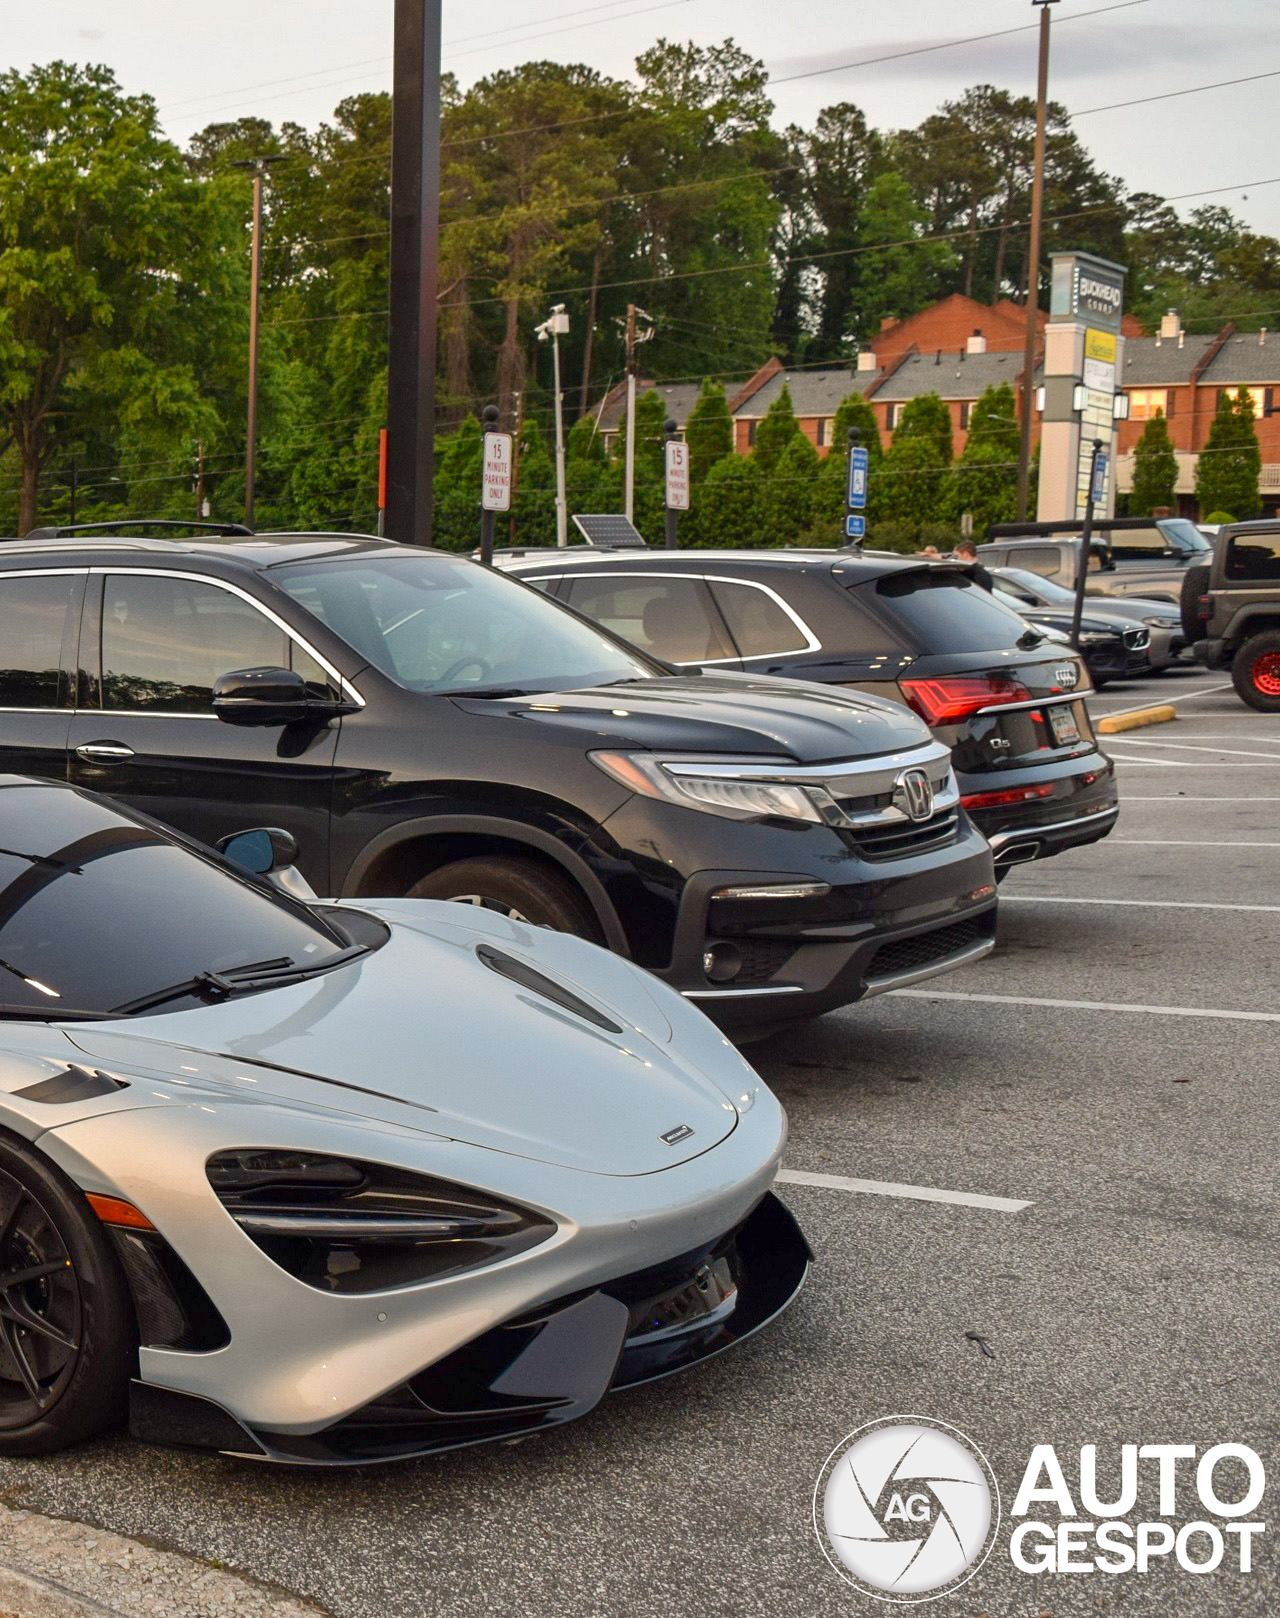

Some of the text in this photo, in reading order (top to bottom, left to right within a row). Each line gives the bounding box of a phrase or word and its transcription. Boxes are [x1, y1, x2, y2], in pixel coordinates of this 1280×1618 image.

[1080, 277, 1121, 307] BUCKHEAD
[493, 443, 502, 459] 15
[672, 449, 683, 465] 15
[487, 461, 508, 473] MINUTE
[484, 474, 509, 487] PARKING
[489, 487, 503, 499] ONLY
[990, 738, 1011, 749] Q5
